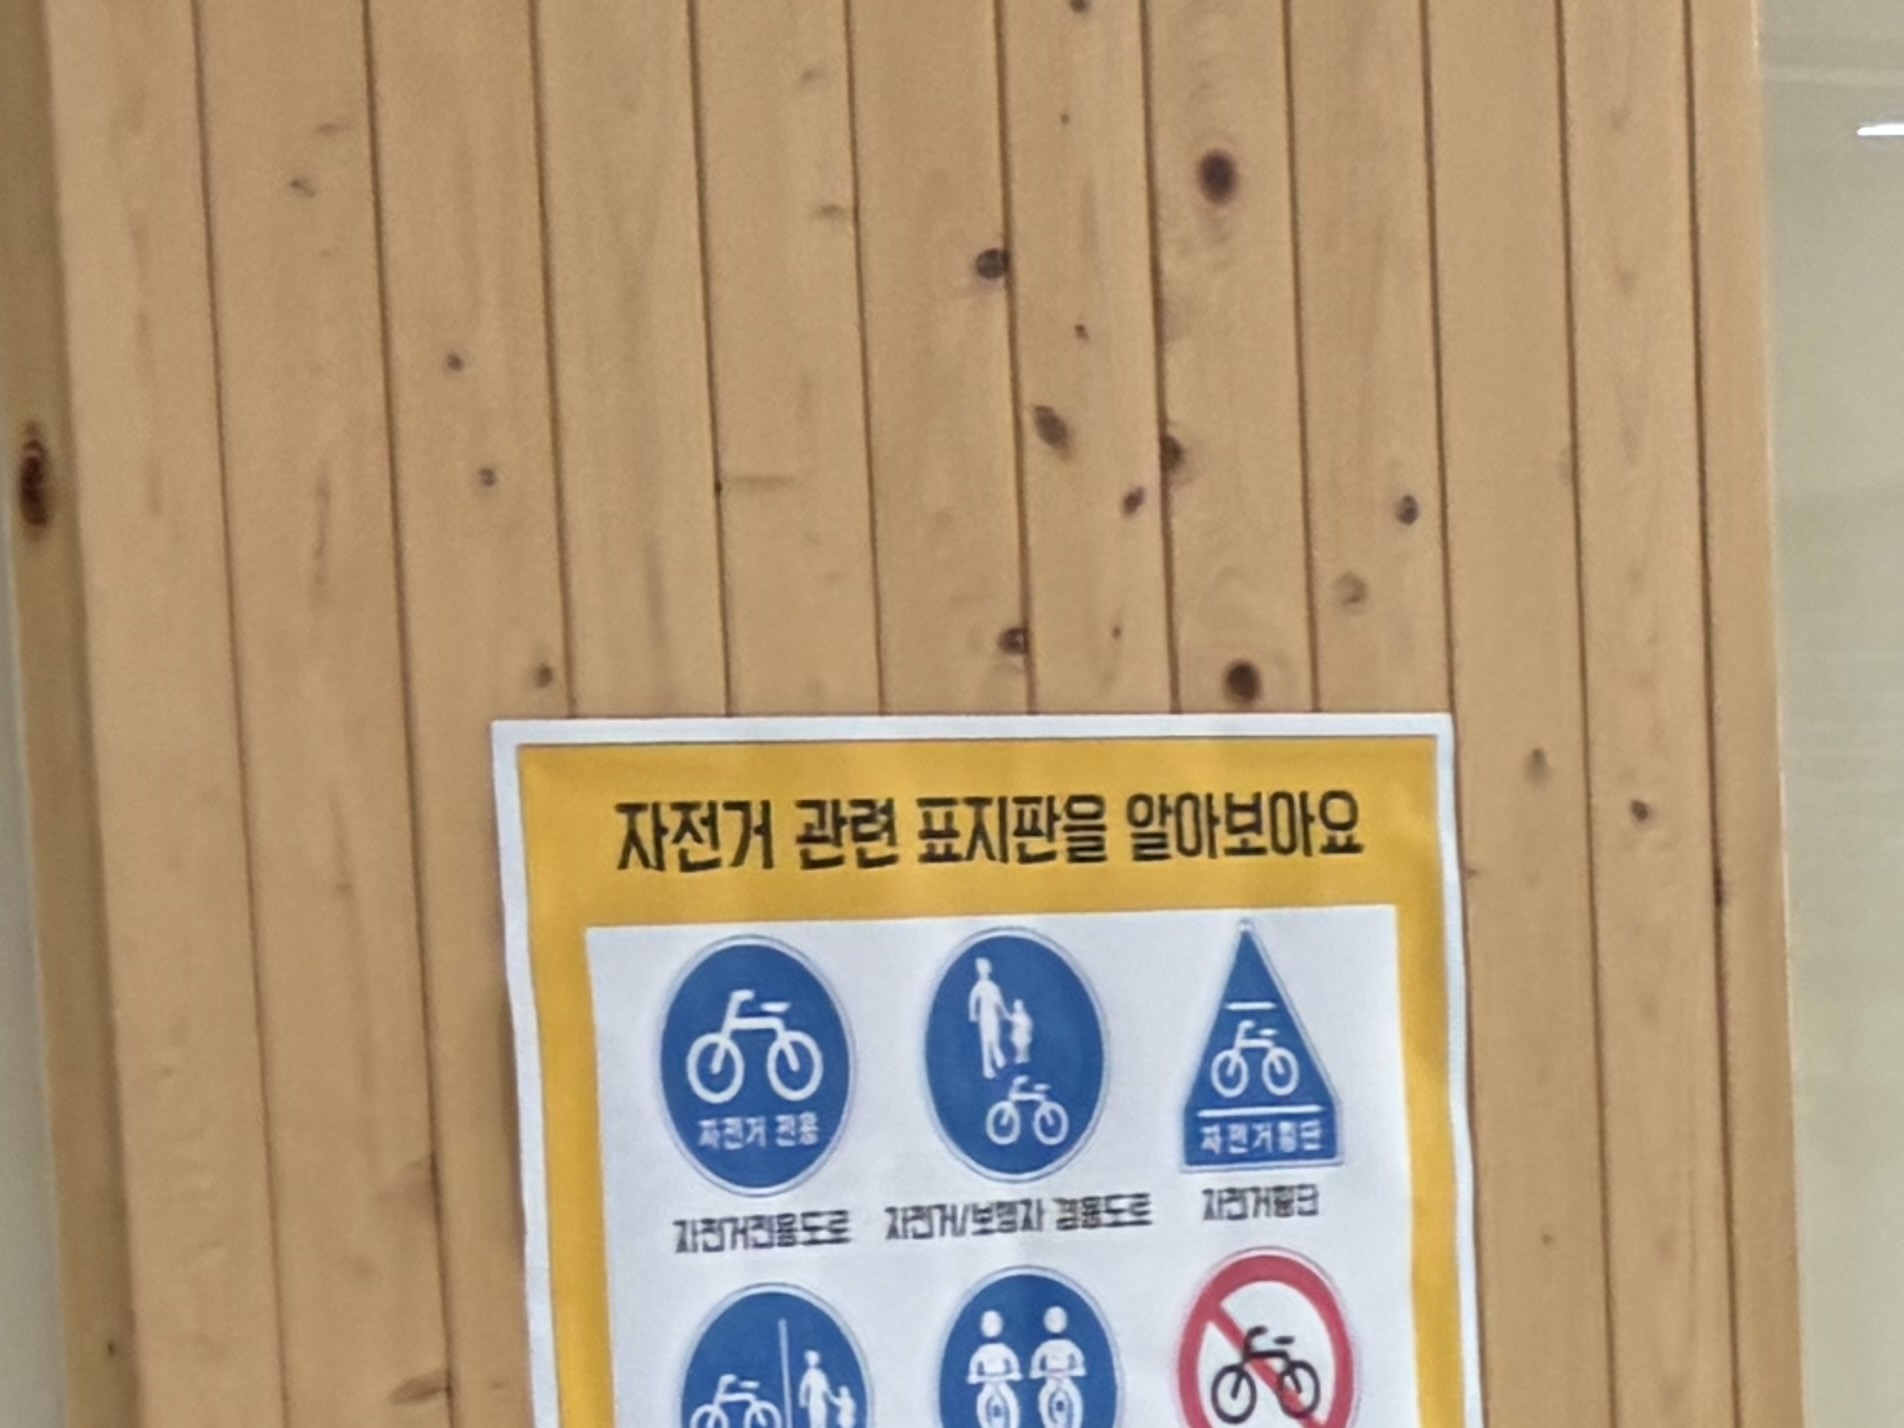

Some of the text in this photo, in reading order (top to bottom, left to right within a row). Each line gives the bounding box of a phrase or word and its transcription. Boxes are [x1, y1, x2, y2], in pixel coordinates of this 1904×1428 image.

[616, 790, 1366, 872] 자전거 관련 표지판을 알아보아요
[697, 1110, 820, 1151] 자전거 전용
[673, 1209, 852, 1254] 자전거전용도로
[884, 1197, 1044, 1241] 자전거/보행자
